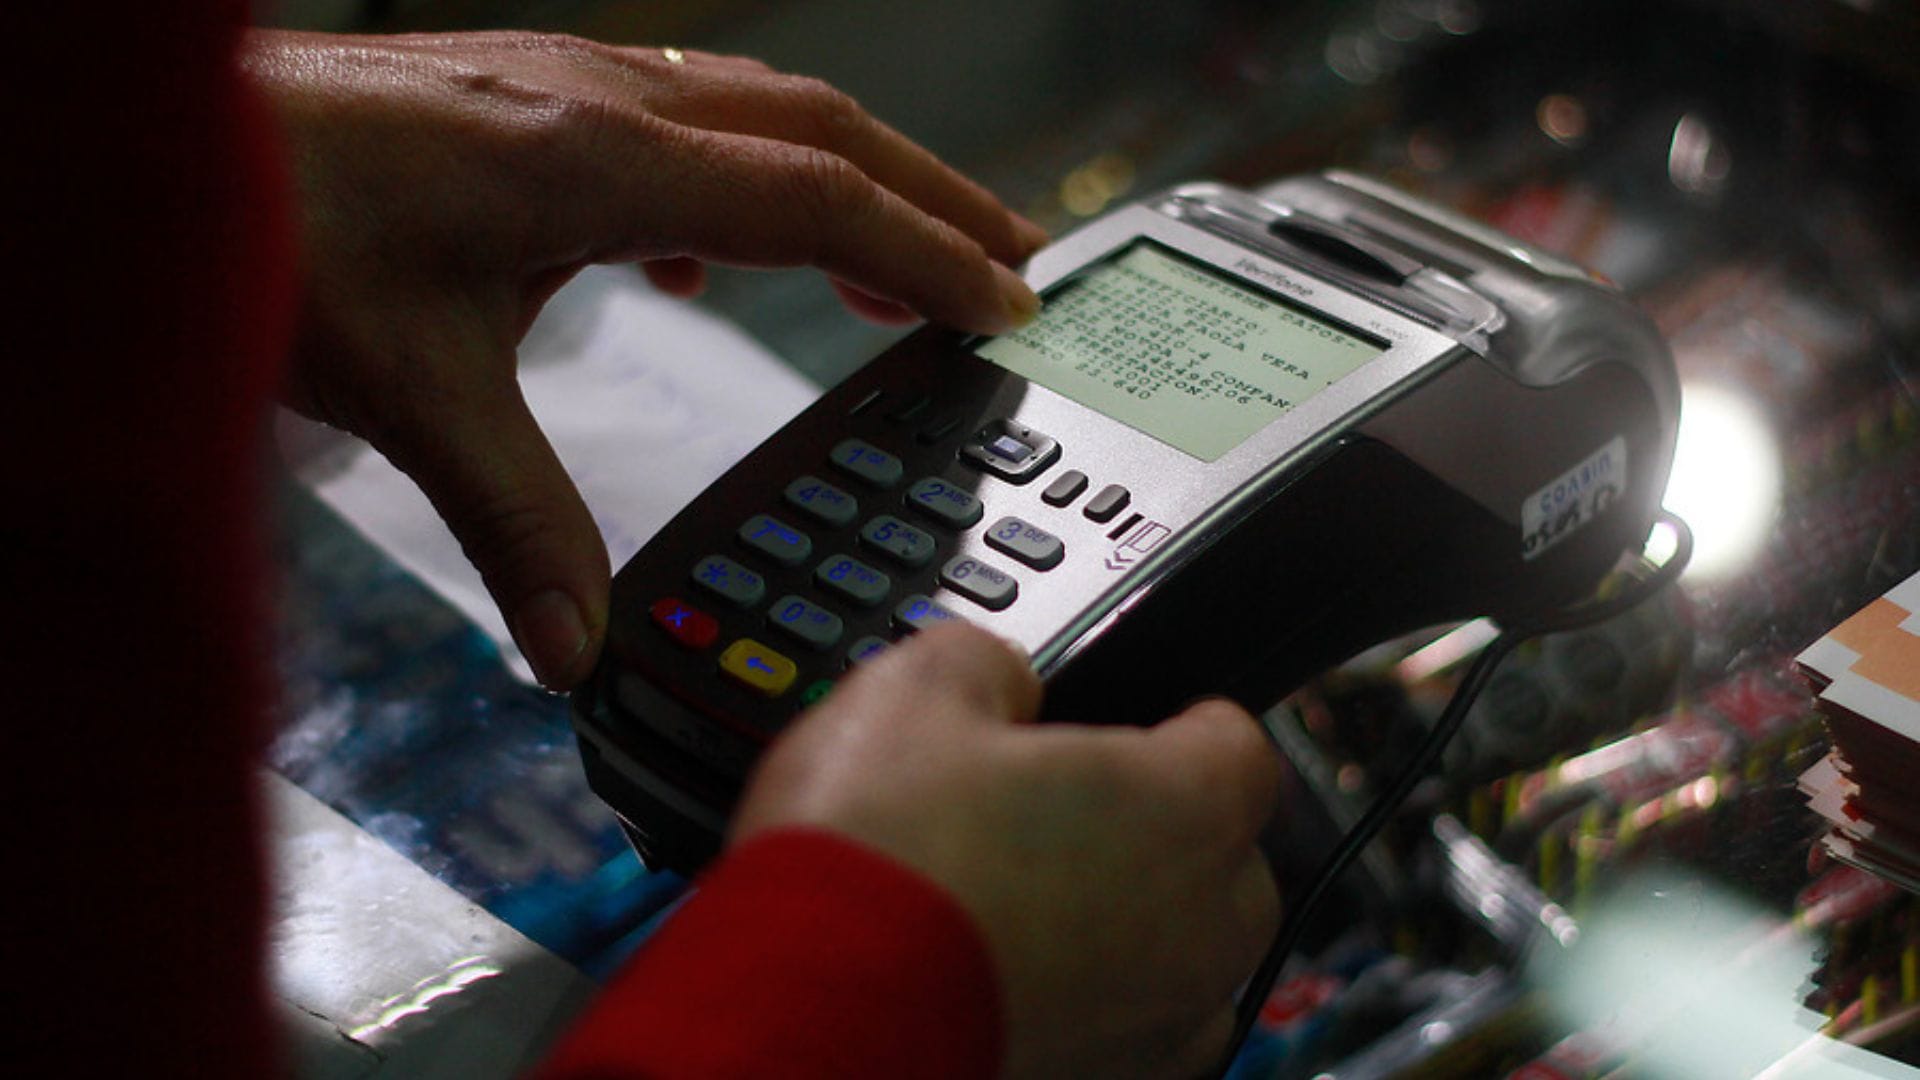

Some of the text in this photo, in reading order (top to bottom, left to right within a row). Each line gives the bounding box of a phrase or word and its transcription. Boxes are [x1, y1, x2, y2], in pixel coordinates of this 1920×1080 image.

[1118, 266, 1270, 335] ENEFICIARIO:
[1183, 319, 1248, 352] PAOLA
[1259, 352, 1311, 380] VERA
[1183, 358, 1202, 368] Y
[846, 446, 865, 465] 1
[798, 486, 821, 502] 4
[920, 483, 945, 502] 2
[751, 518, 778, 540] 7
[873, 521, 898, 541] 5
[998, 522, 1049, 543] 3 DEF
[828, 560, 853, 582] 8
[952, 560, 1006, 585] 6 MNO
[781, 602, 806, 623] 0
[904, 600, 930, 620] 9
